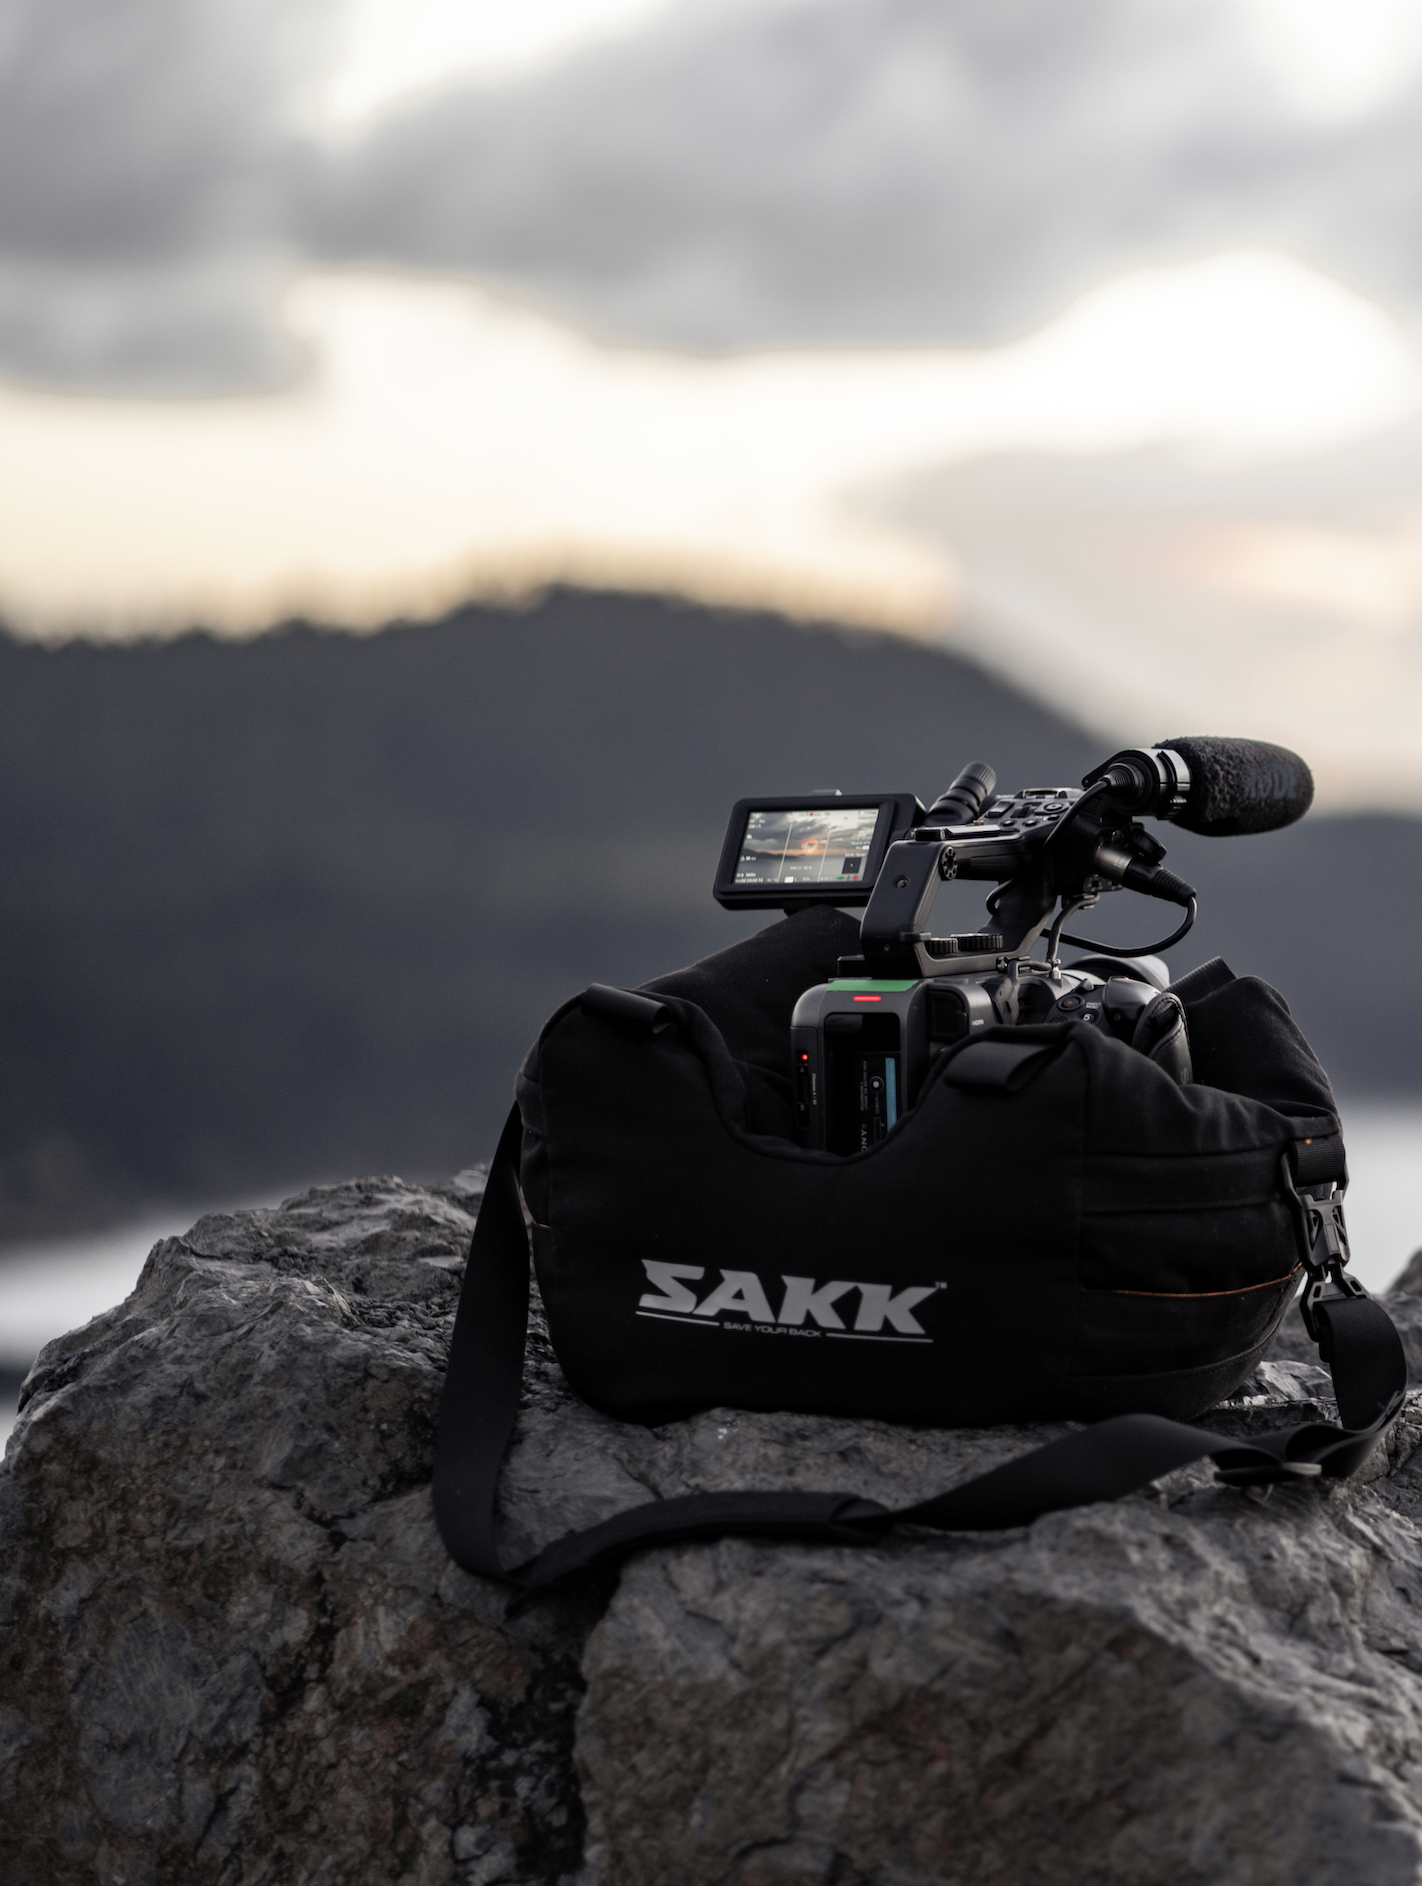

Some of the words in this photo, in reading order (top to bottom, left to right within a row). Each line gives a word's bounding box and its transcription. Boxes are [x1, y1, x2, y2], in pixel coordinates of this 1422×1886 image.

[638, 1259, 938, 1335] SAKK
[723, 1321, 752, 1332] SAVE
[755, 1325, 787, 1335] YOUR
[789, 1328, 822, 1338] BACK
